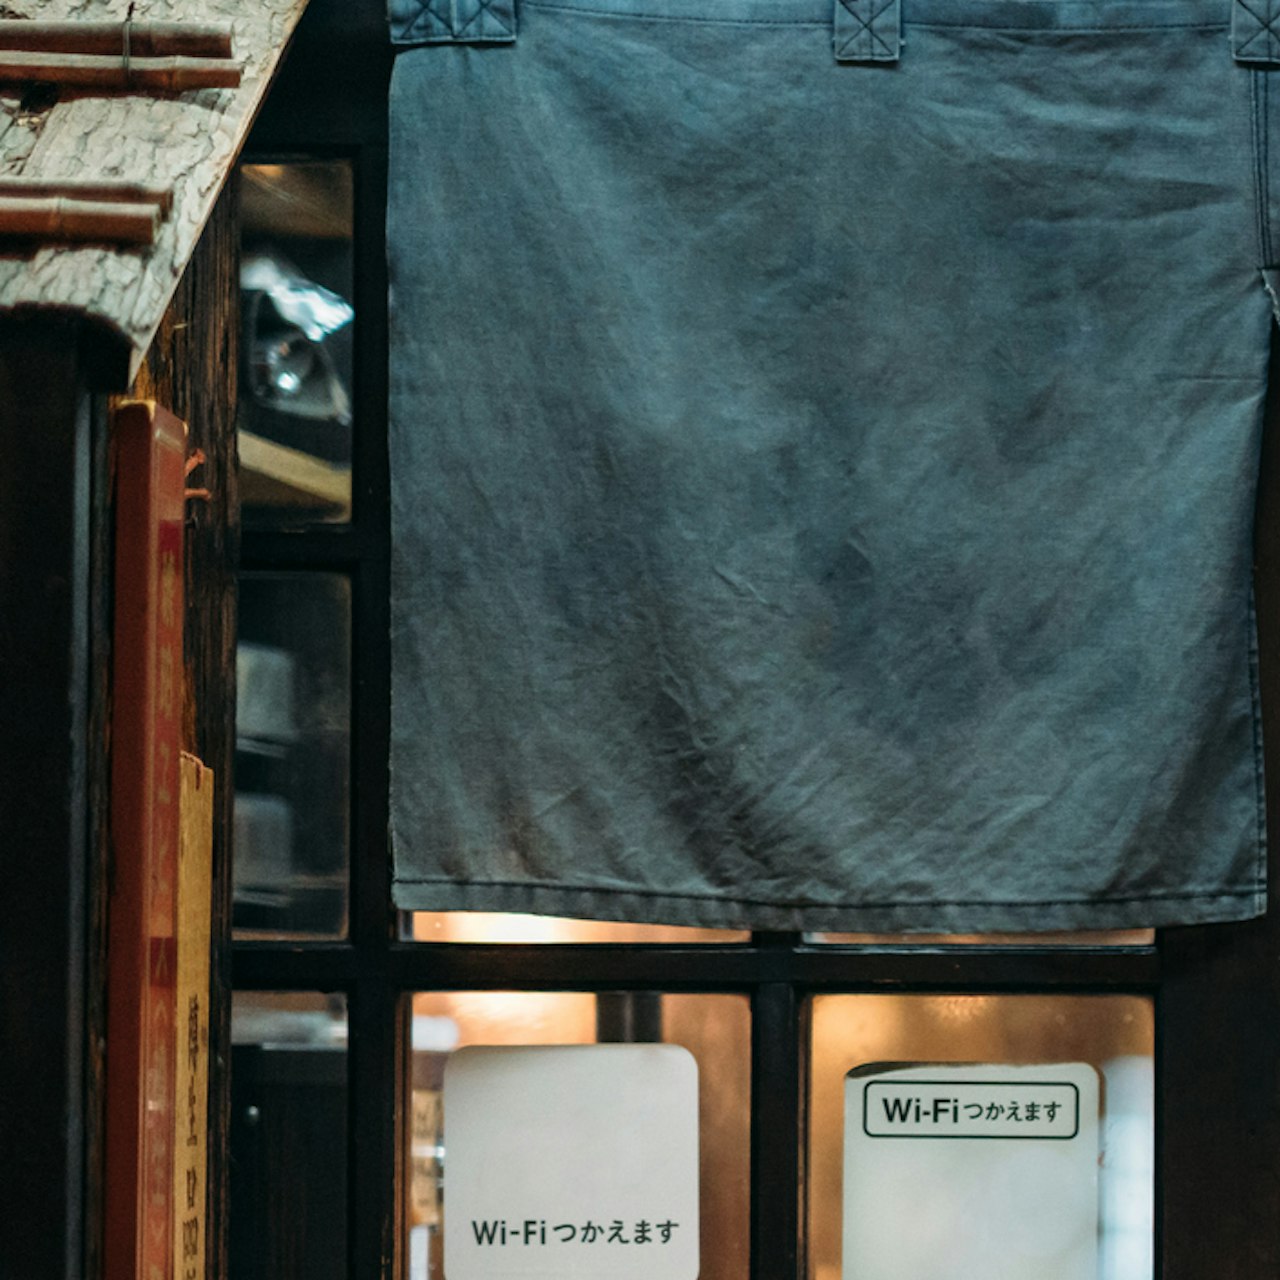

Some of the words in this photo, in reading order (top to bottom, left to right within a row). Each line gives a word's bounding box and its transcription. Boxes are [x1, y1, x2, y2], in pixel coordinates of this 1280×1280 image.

[882, 1098, 959, 1123] Wi-Fi
[963, 1101, 1062, 1123] つかえます
[472, 1220, 546, 1246] Wi-Fi
[553, 1219, 679, 1244] つかえます
